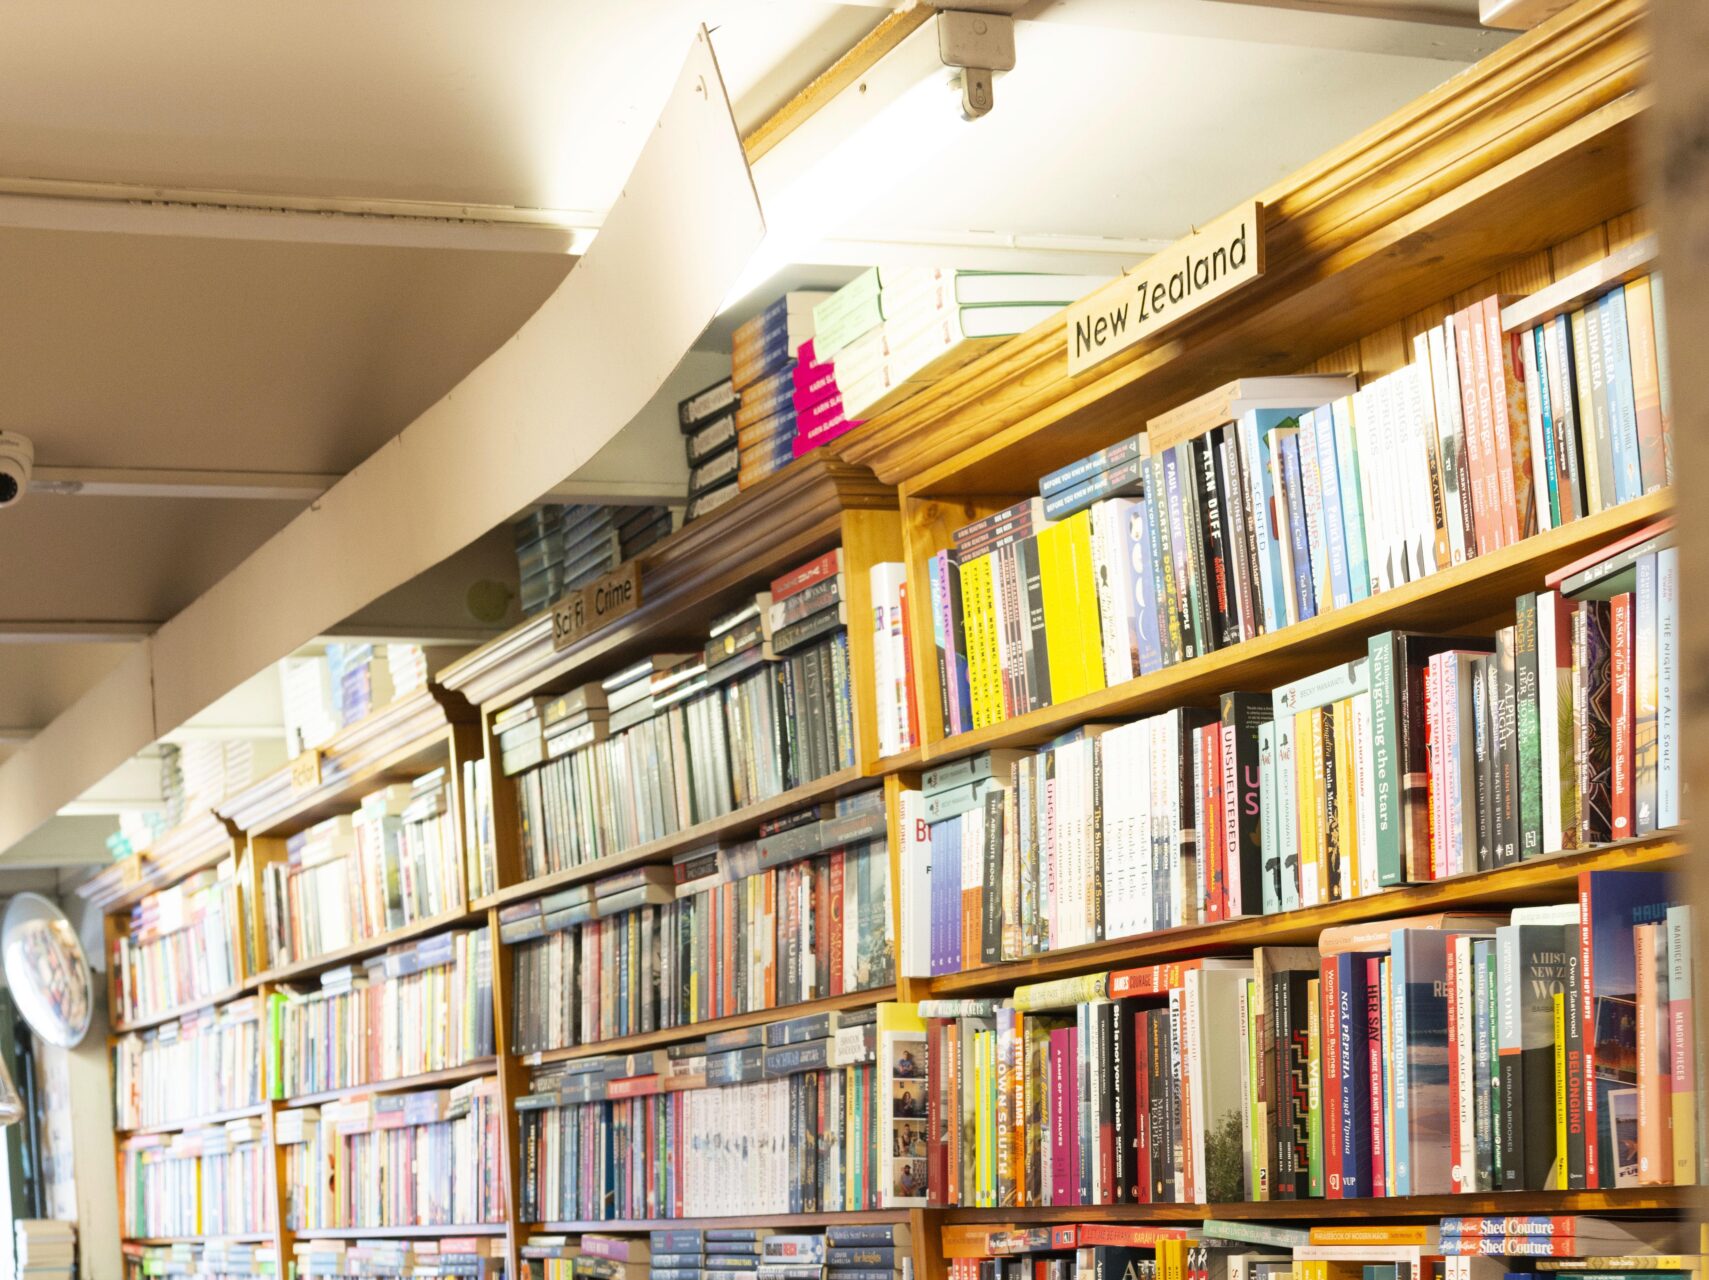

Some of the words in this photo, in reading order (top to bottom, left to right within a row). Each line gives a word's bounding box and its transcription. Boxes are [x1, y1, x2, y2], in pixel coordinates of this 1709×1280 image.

[1076, 306, 1129, 358] New
[1137, 225, 1247, 323] Zealand
[1600, 312, 1615, 384] IHIMAERA
[1167, 463, 1177, 493] PAUL
[1202, 451, 1216, 496] ALAN
[1170, 497, 1181, 538] CLEAVE
[1208, 499, 1220, 539] DUFF
[1253, 482, 1266, 551] SCENTED
[556, 609, 571, 637] Sci
[576, 601, 584, 626] Fi
[595, 579, 632, 615] Crime
[1616, 608, 1624, 647] SEASON
[1526, 609, 1534, 652] NALINI
[1616, 649, 1623, 657] of
[1374, 648, 1386, 746] Navigating
[1526, 672, 1535, 711] QUIET
[1616, 674, 1624, 694] JEW
[1505, 684, 1514, 737] ALPHA
[1520, 699, 1528, 743] BONES
[1529, 719, 1535, 734] IN
[1378, 750, 1386, 780] the
[1225, 730, 1236, 852] UNSHELTERED
[1379, 783, 1388, 832] Stars
[1328, 970, 1336, 1006] Women
[1569, 957, 1578, 986] Owen
[1368, 985, 1379, 1014] HER
[1504, 984, 1513, 1039] WOMEN
[1570, 990, 1580, 1038] Eastwood
[1114, 1031, 1120, 1040] is
[1369, 1018, 1380, 1041] SAY
[1015, 1038, 1023, 1080] STEVEN
[1395, 996, 1404, 1109] RECREATIONALISTS
[1309, 1060, 1319, 1110] WEED
[1569, 1051, 1580, 1133] BELONGING
[999, 1113, 1007, 1174] SOUTH
[1478, 1238, 1505, 1255] Shed
[1509, 1237, 1554, 1255] Couture
[1479, 1220, 1506, 1236] Shed
[1509, 1220, 1554, 1236] Couture
